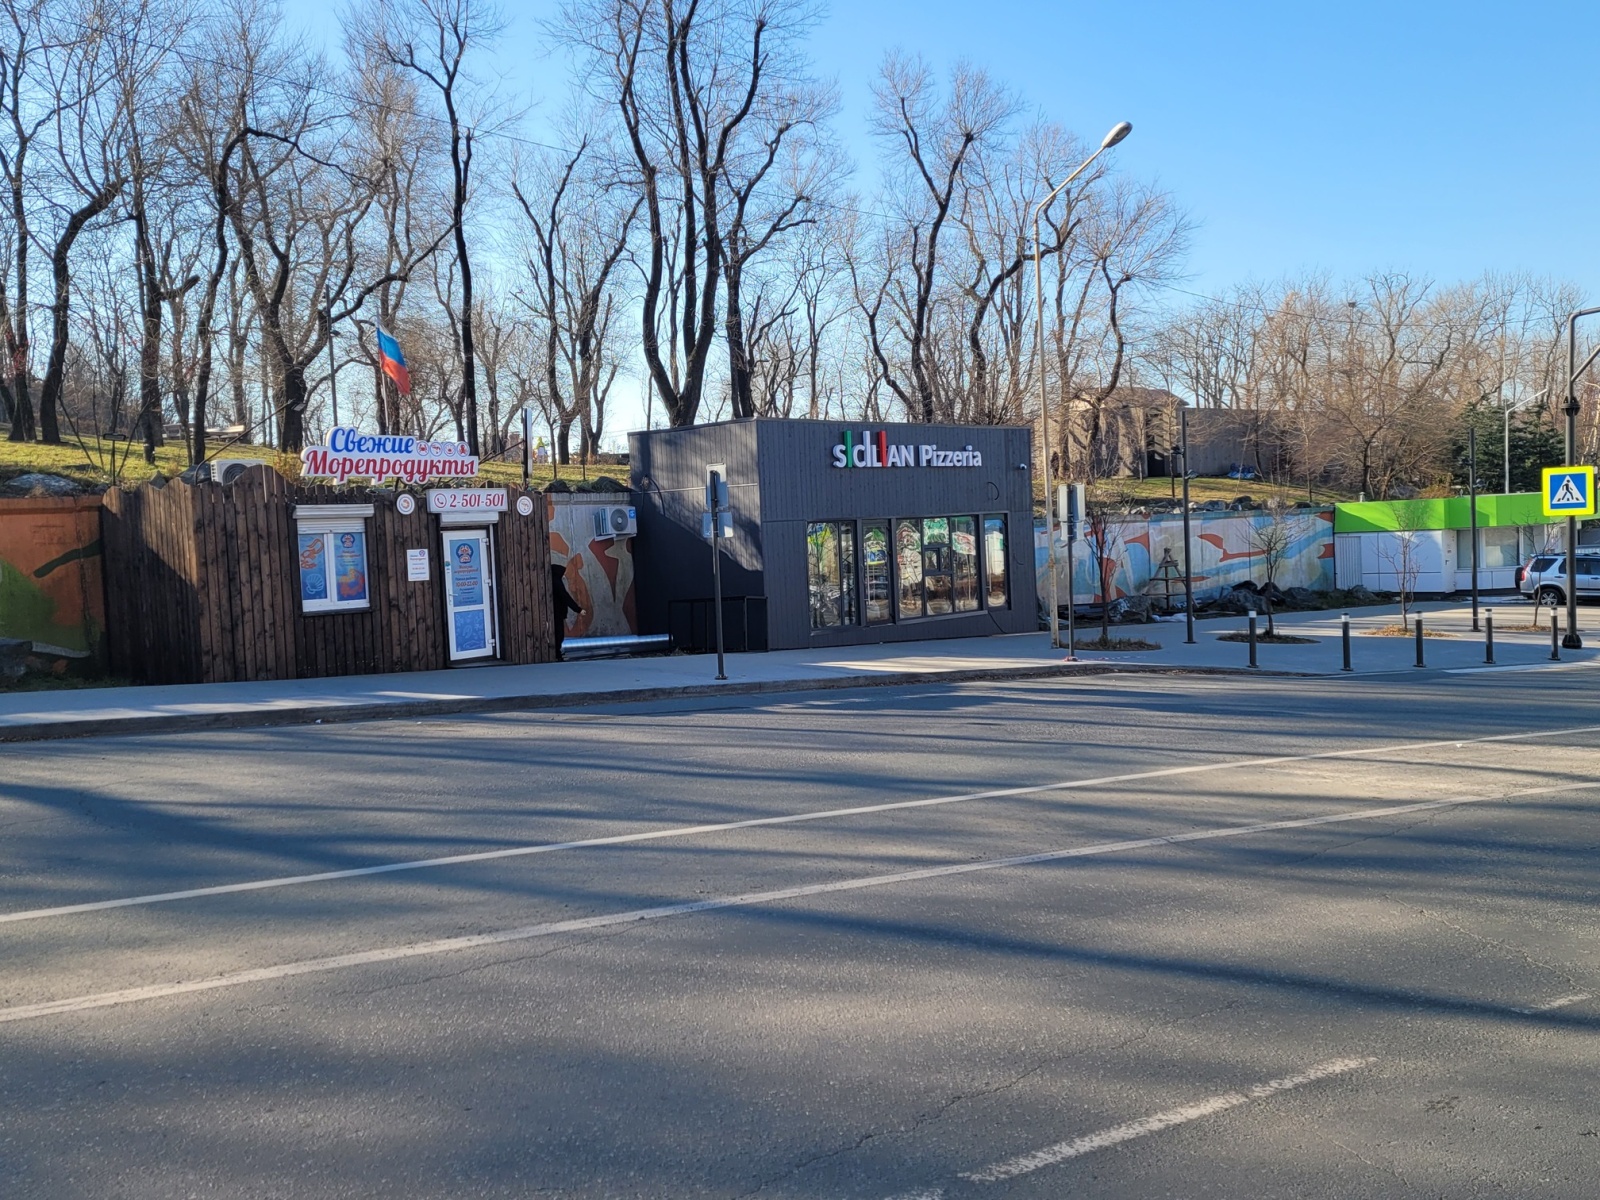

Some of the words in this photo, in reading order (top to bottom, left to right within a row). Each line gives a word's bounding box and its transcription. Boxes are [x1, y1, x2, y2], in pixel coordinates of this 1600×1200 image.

[330, 428, 415, 454] Свежие
[832, 430, 915, 468] SICILIAN
[918, 444, 983, 467] Pizzeria
[305, 450, 476, 483] Морепродукты
[449, 493, 505, 508] 2-501-501
